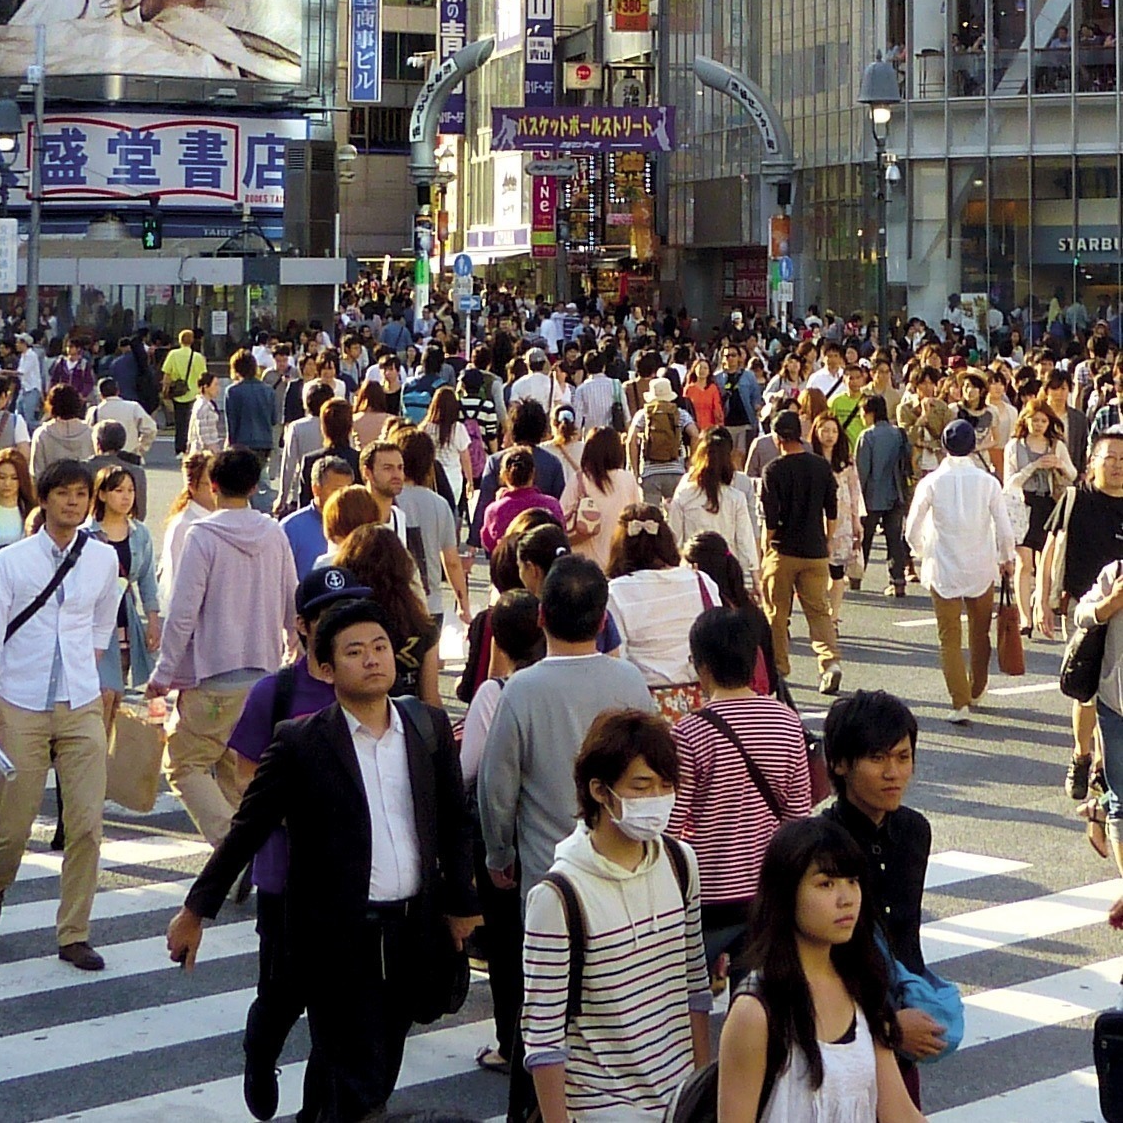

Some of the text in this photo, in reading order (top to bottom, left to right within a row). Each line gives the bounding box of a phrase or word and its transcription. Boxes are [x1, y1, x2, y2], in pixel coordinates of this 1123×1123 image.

[517, 114, 653, 138] バスケットボールストリート
[244, 194, 268, 203] BOOKS
